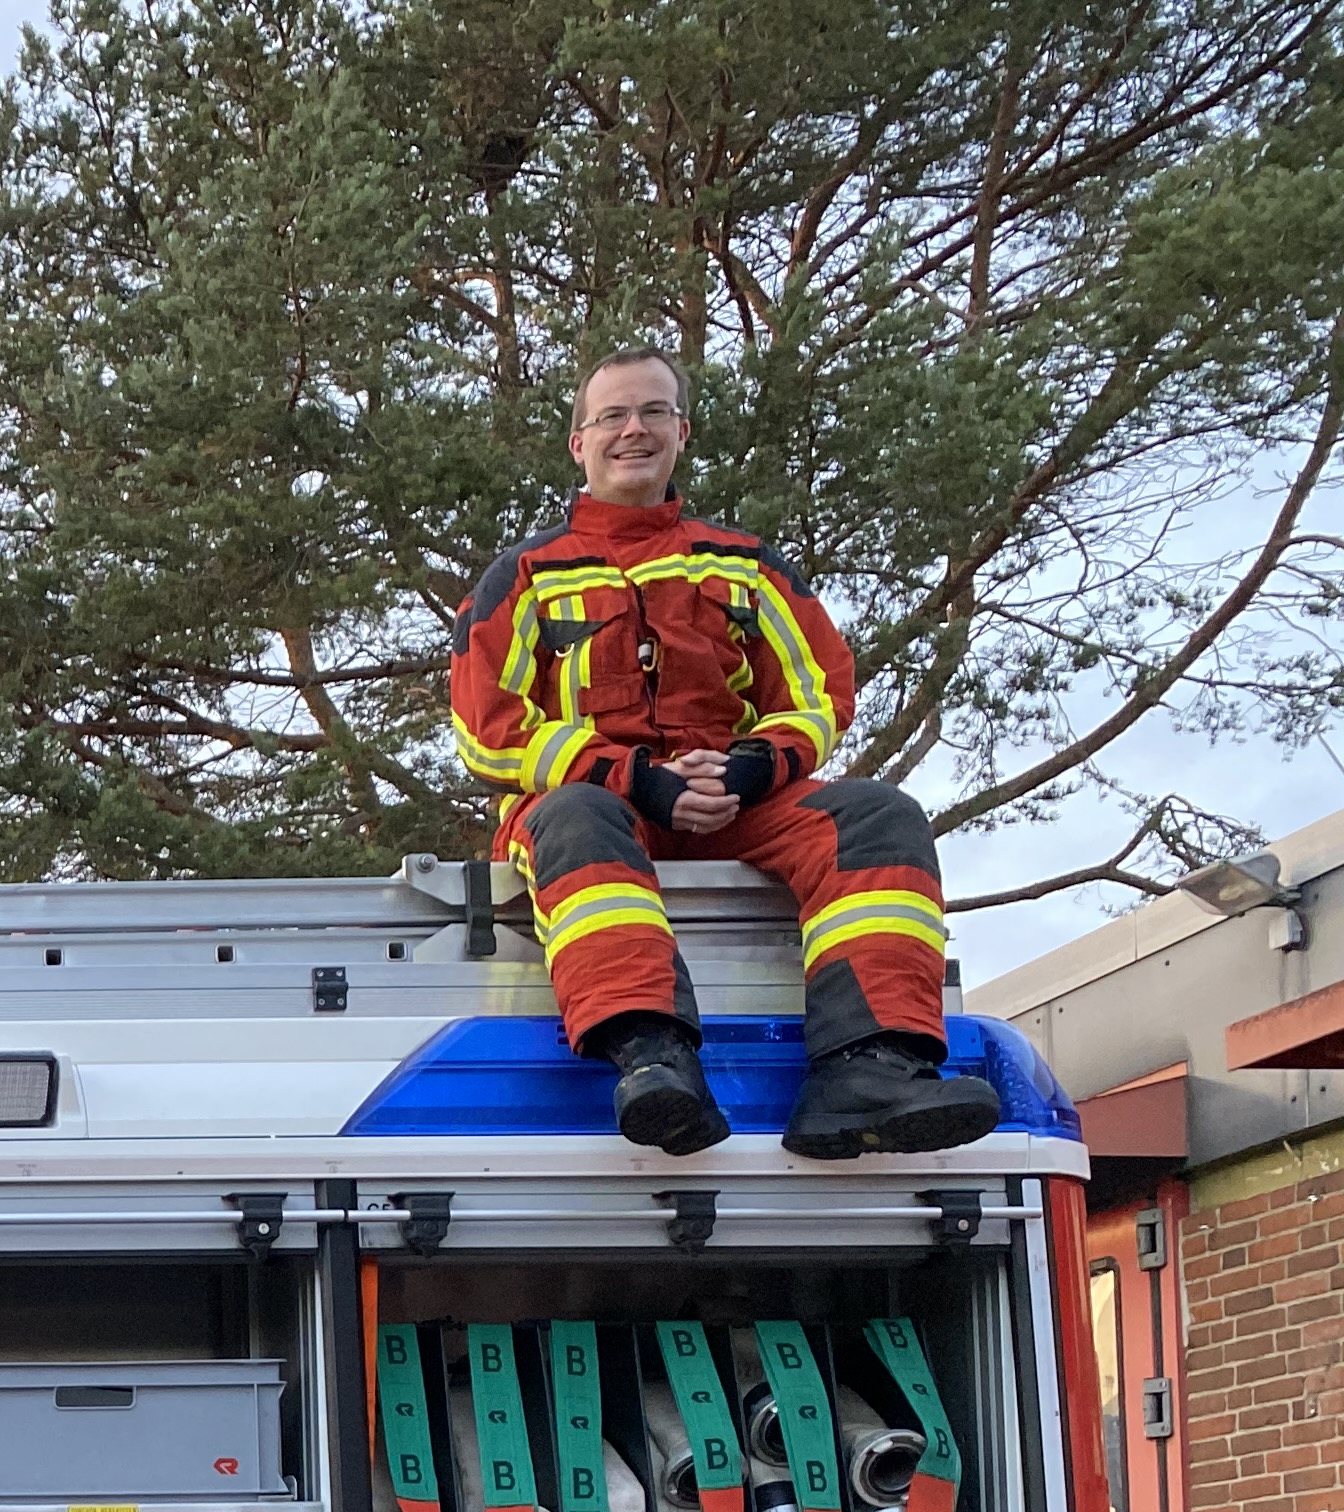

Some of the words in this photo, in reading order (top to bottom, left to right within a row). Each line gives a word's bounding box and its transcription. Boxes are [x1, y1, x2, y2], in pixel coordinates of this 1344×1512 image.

[672, 1330, 697, 1357] B
[883, 1321, 908, 1348] B
[385, 1335, 408, 1365] B
[481, 1343, 503, 1373] B
[566, 1345, 587, 1377] B
[776, 1343, 803, 1370] B
[704, 1438, 729, 1470] B
[935, 1427, 951, 1459] B
[400, 1454, 423, 1484] B
[493, 1460, 516, 1491] B
[573, 1467, 595, 1499] B
[806, 1460, 827, 1492] B
